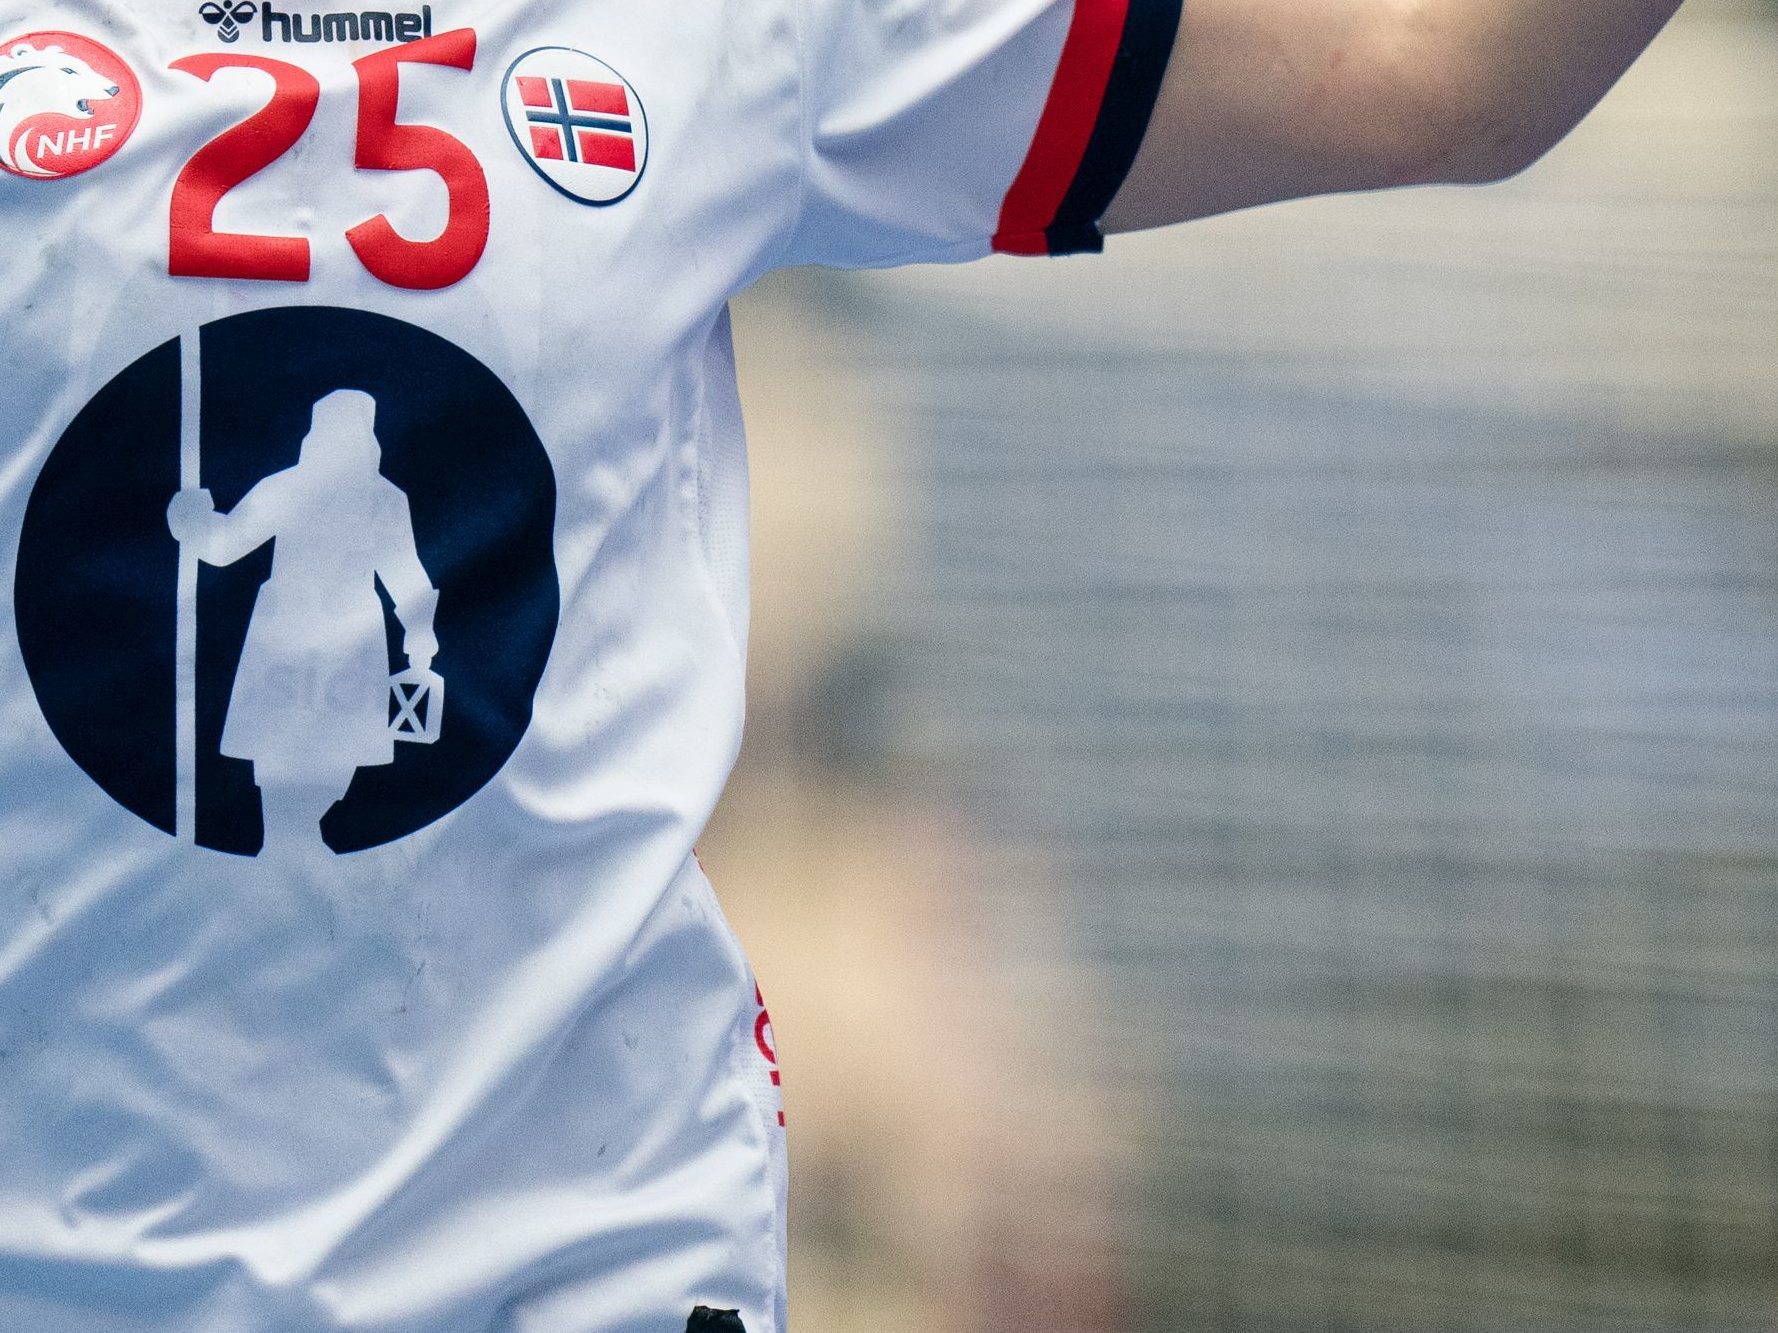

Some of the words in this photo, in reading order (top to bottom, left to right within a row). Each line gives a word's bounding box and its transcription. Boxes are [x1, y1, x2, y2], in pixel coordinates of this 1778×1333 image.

[261, 1, 432, 43] hummel
[37, 123, 118, 160] NHF
[167, 27, 491, 291] 25
